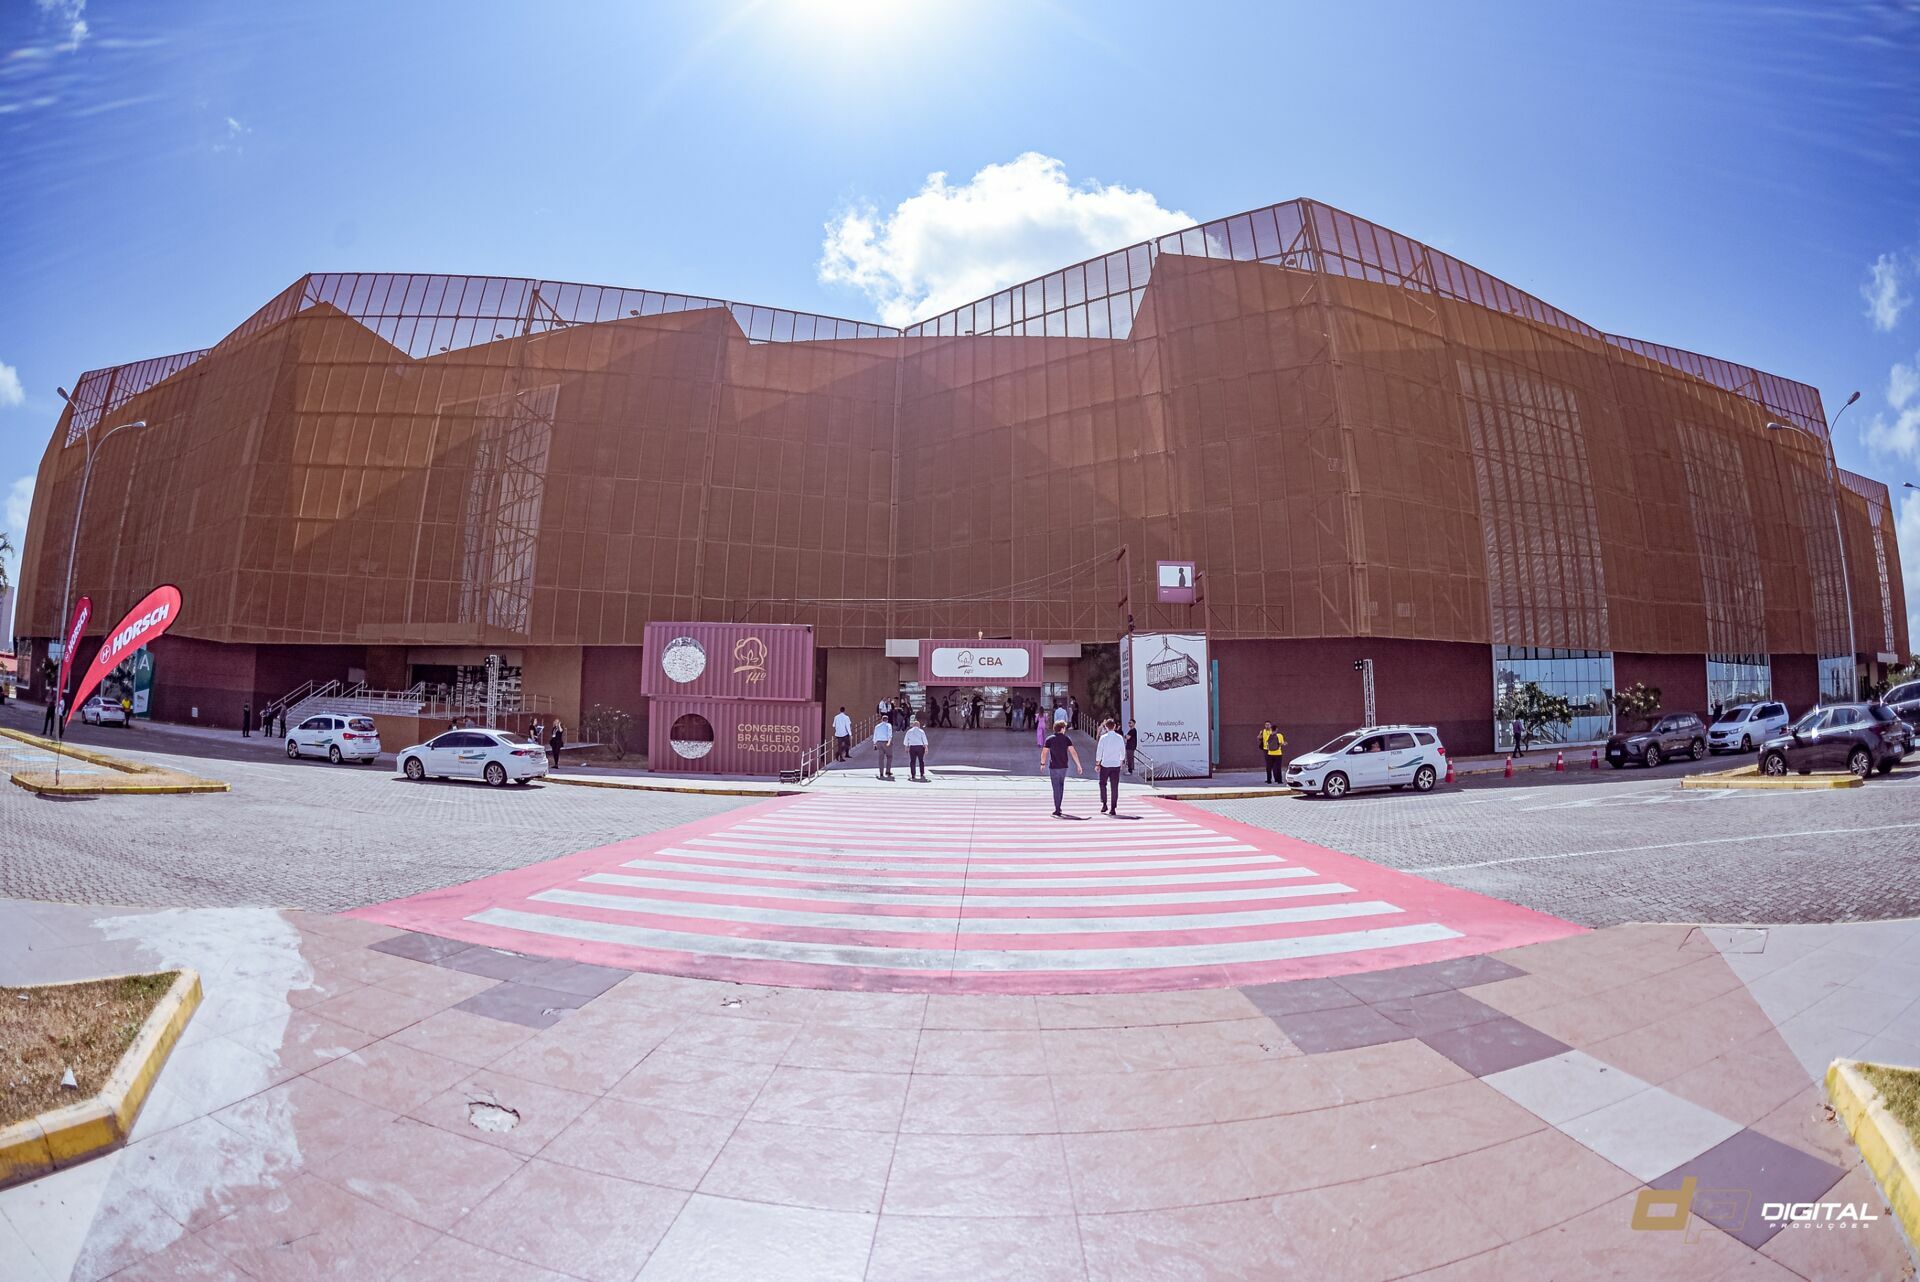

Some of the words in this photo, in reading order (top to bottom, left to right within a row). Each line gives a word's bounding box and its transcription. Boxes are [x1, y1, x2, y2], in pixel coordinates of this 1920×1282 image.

[68, 607, 88, 654] HORSCH
[112, 603, 170, 656] HORSCH
[139, 654, 150, 671] A
[978, 657, 1003, 666] CBA
[737, 723, 801, 734] CONGRESSO
[737, 733, 800, 744] BRASILEIRO
[1156, 731, 1200, 742] ABRAPA
[748, 742, 800, 753] ALGODÃO
